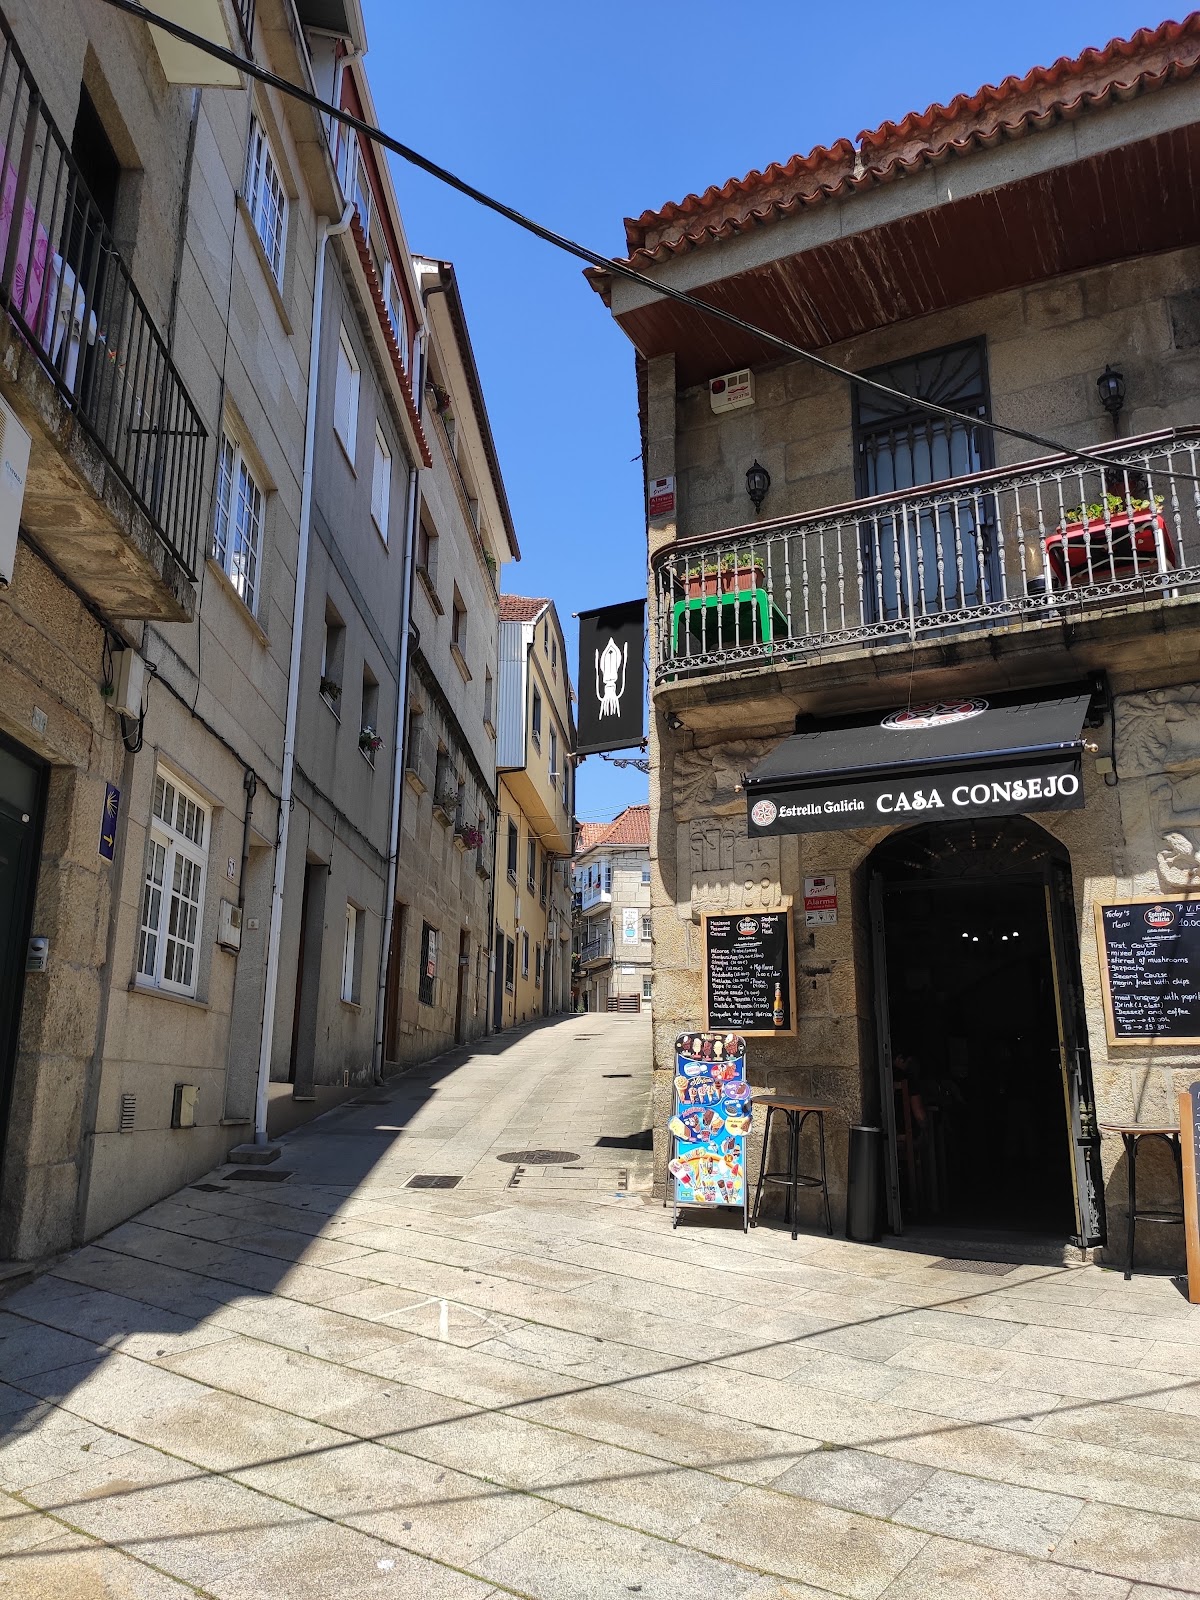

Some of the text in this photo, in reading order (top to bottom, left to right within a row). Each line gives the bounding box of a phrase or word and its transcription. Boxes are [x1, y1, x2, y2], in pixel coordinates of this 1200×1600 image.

[876, 774, 1079, 813] CASA CONSEJO
[778, 803, 823, 818] Estrella
[824, 799, 865, 814] Galicia
[806, 898, 834, 906] Alarma
[1105, 909, 1130, 918] Today's
[1136, 948, 1156, 956] salad
[1139, 956, 1146, 965] of
[1148, 956, 1189, 964] mushrooms
[1135, 978, 1152, 989] fried
[1172, 978, 1190, 987] chips
[1163, 991, 1179, 1000] with
[1167, 1007, 1190, 1017] coffee
